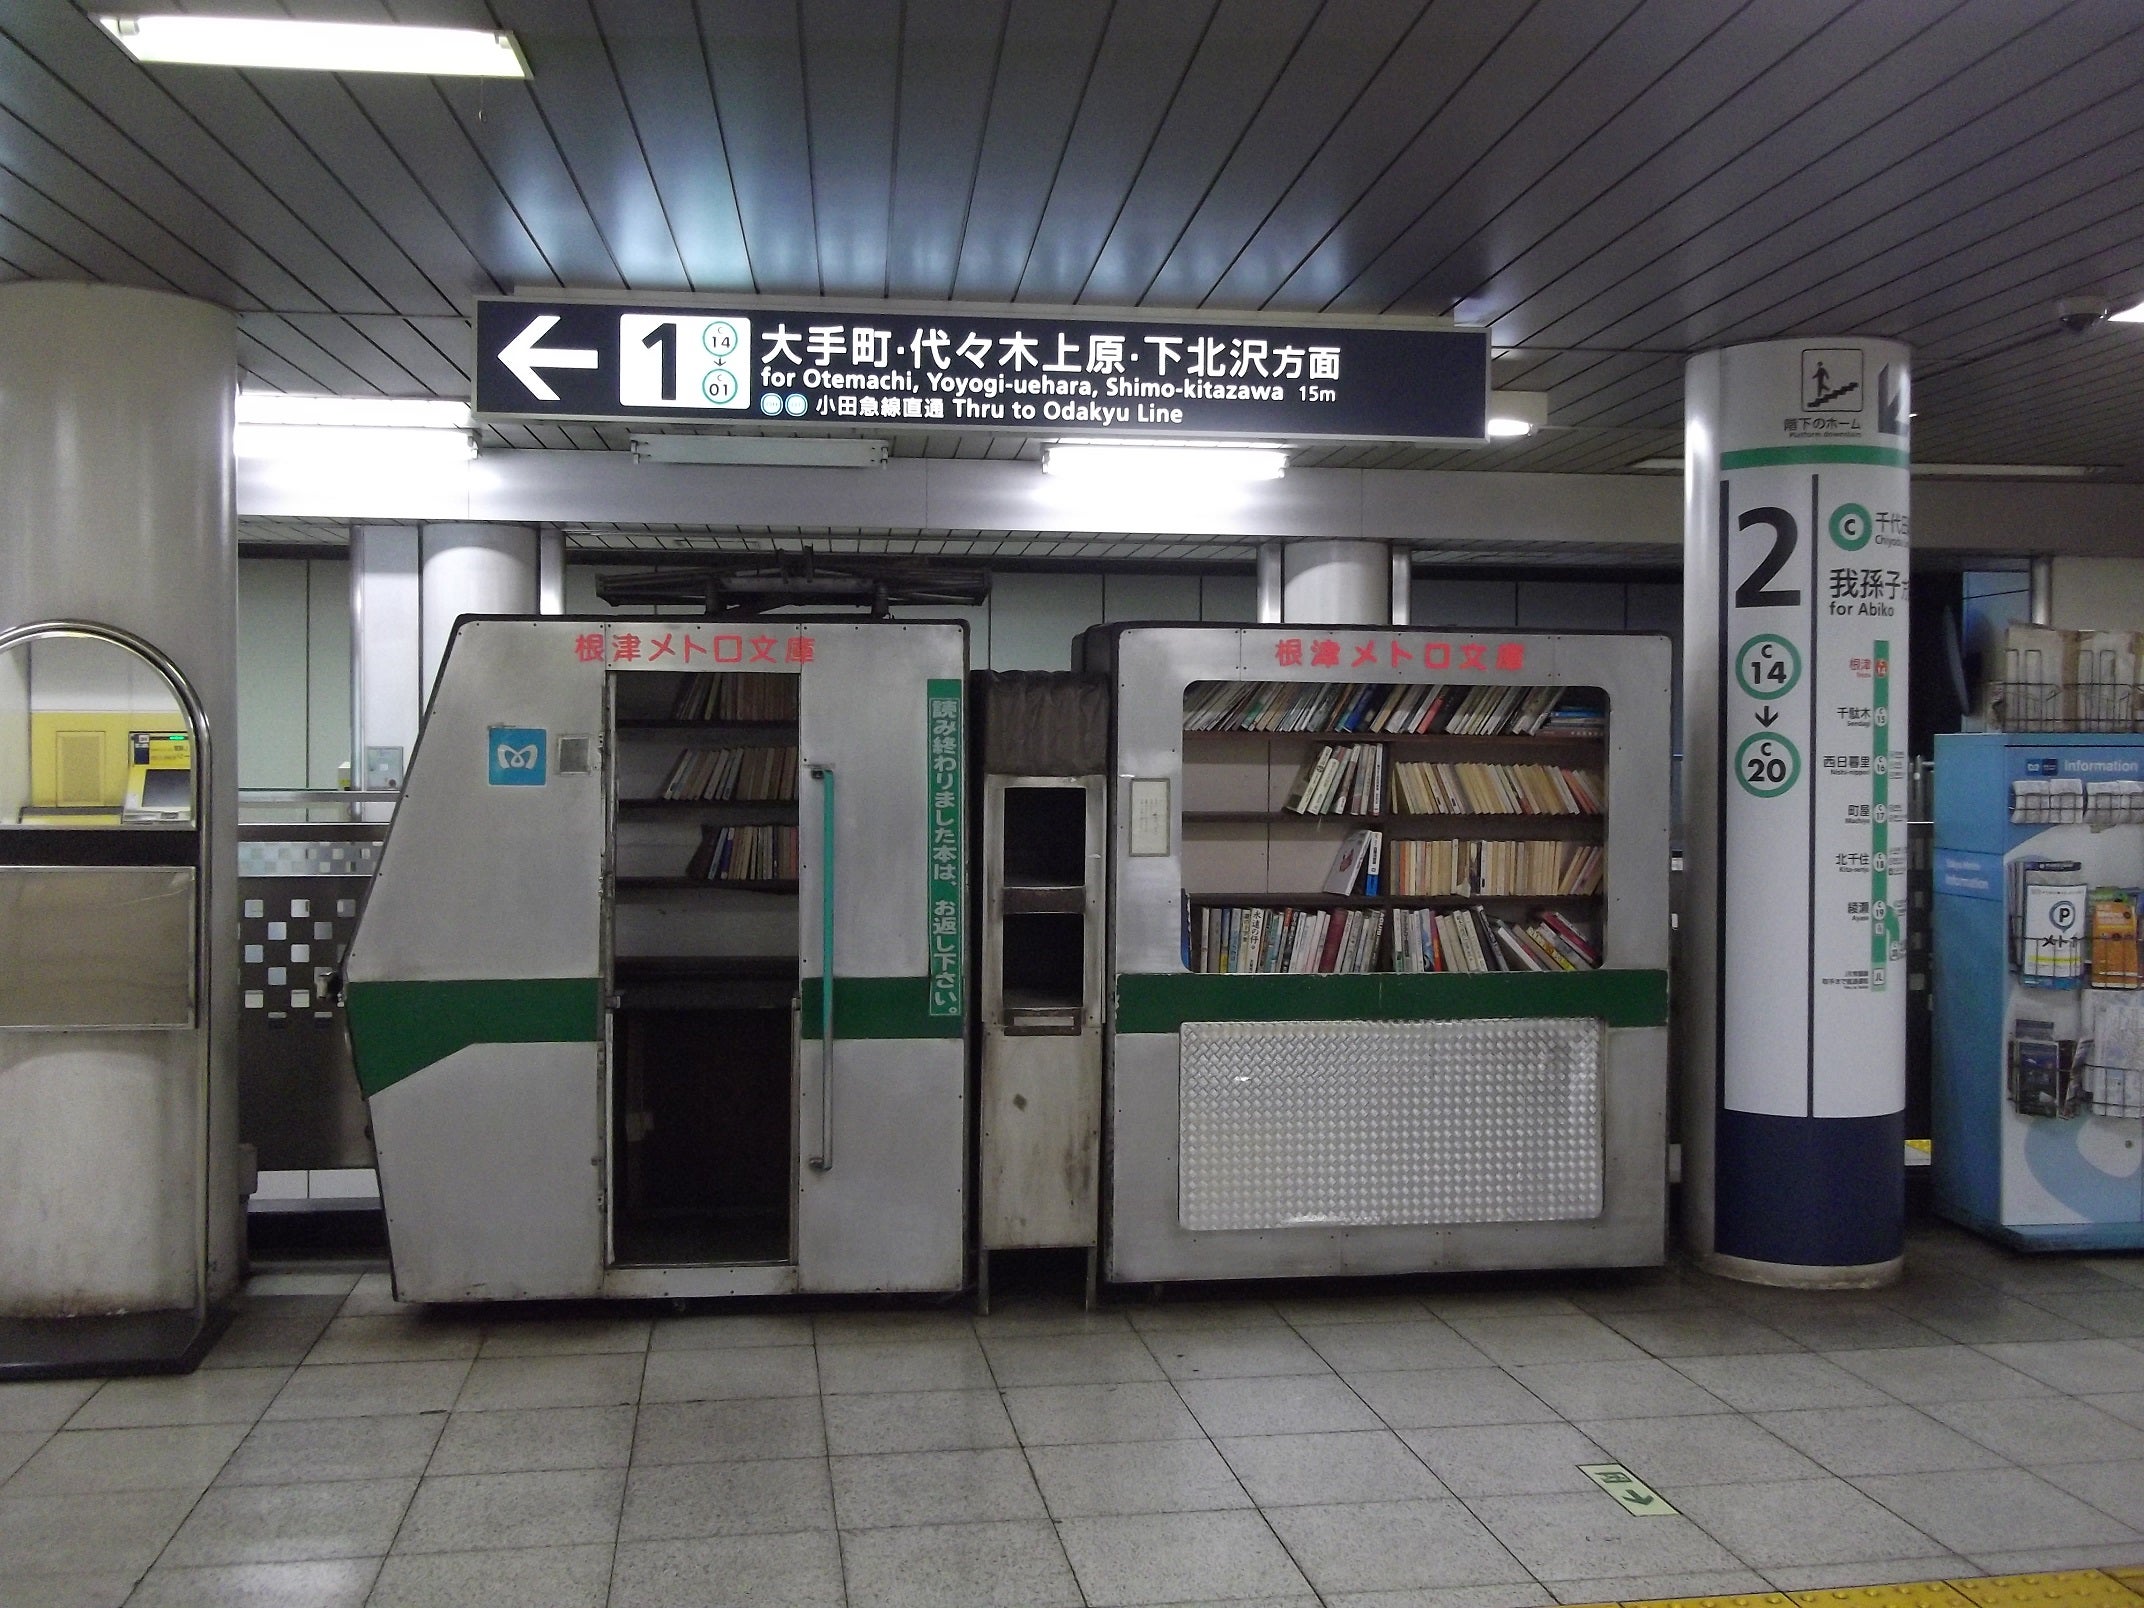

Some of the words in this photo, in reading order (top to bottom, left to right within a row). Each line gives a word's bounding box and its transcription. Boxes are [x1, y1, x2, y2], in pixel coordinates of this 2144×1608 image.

[712, 336, 730, 348] 14
[642, 323, 677, 400] 1
[709, 383, 728, 396] 01
[761, 366, 796, 387] for
[803, 368, 919, 393] Otemachi,
[927, 372, 1098, 398] Yoyogi-uehara,
[1106, 377, 1284, 401] Shimo-kitazawa
[1299, 386, 1336, 402] 15m
[815, 395, 944, 418] 小田急線直通
[953, 398, 1005, 419] Thru
[1012, 401, 1036, 420] to
[1044, 401, 1129, 426] Odakyu
[1138, 404, 1183, 423] Line
[1844, 518, 1856, 536] C
[1735, 506, 1801, 608] 2
[1829, 602, 1853, 616] for
[1858, 602, 1895, 617] Abiko
[575, 633, 816, 664] 根津メトロ文庫
[1275, 638, 1526, 672] 根津メトロ文庫
[1761, 644, 1773, 659] C
[1751, 661, 1787, 685] 14
[1760, 742, 1772, 757] C
[1748, 759, 1787, 783] 20
[2064, 759, 2139, 773] Information
[1835, 853, 1870, 866] 北千住
